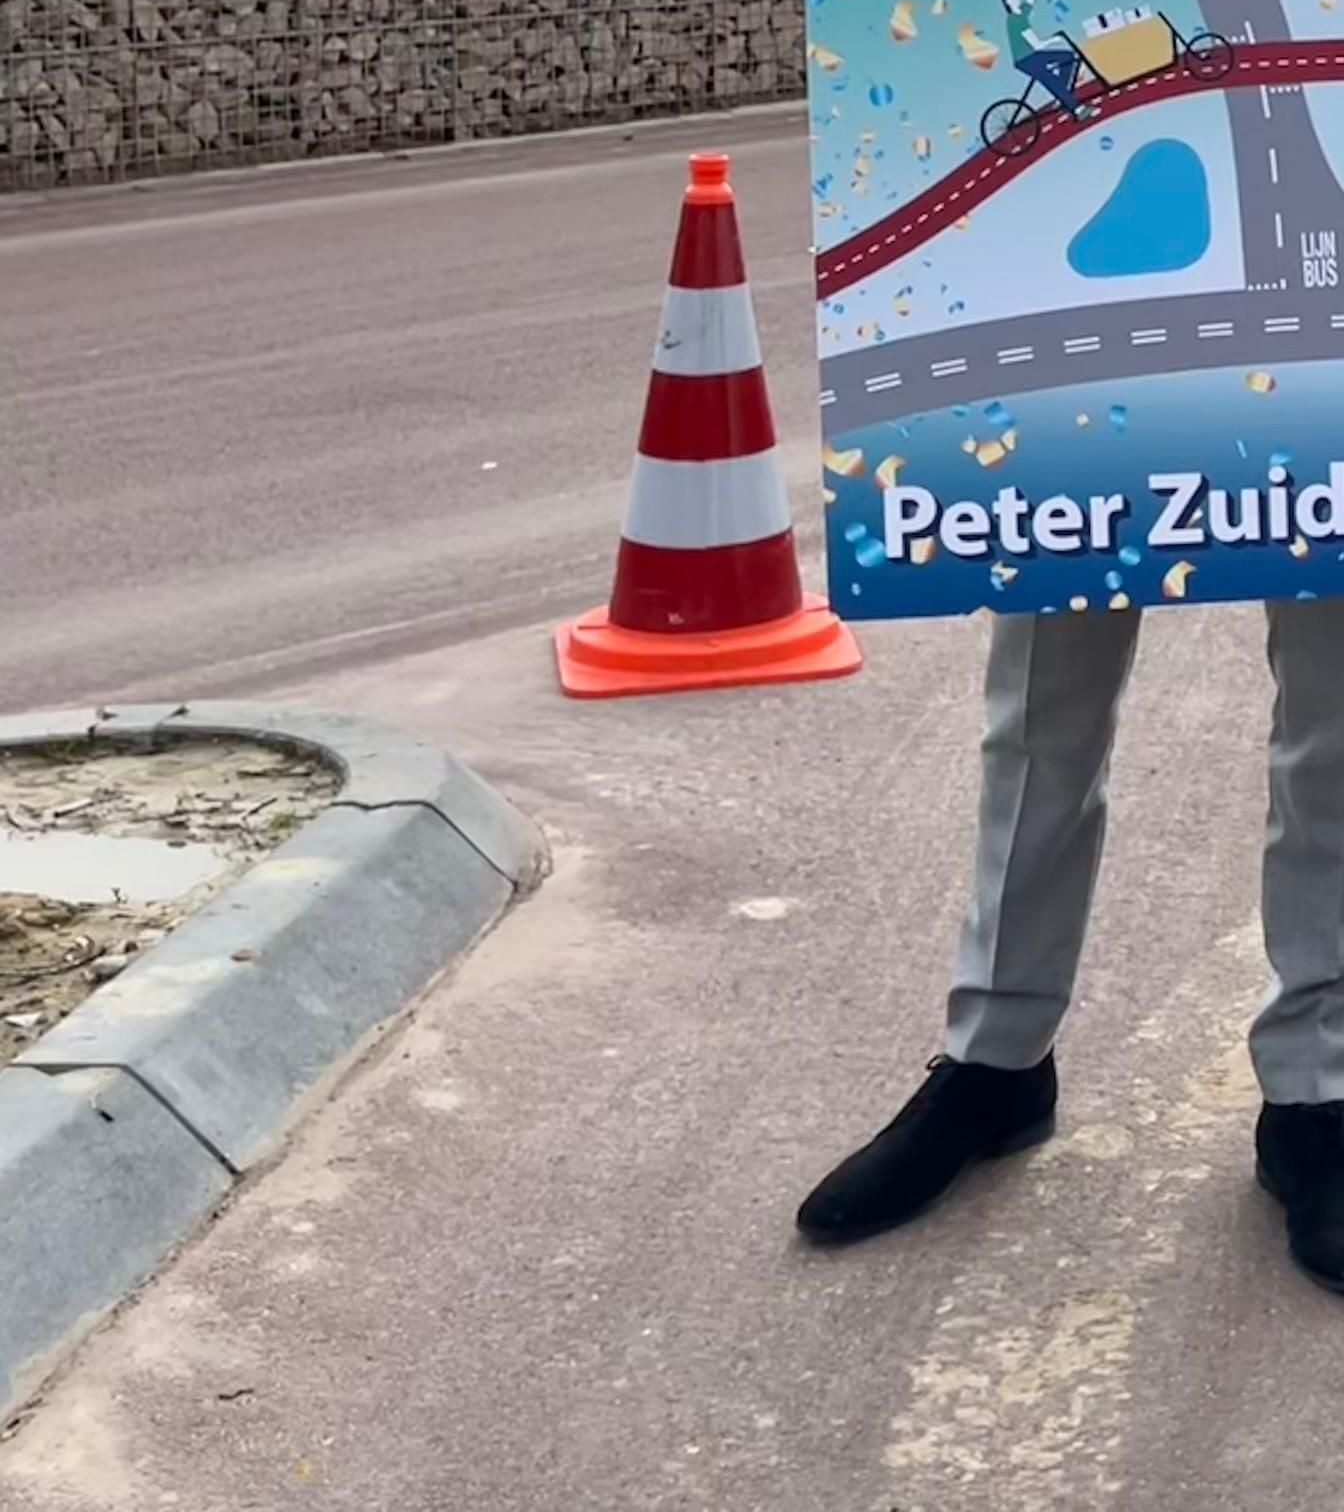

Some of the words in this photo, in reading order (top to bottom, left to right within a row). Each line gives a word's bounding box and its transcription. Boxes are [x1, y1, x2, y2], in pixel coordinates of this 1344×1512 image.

[1301, 231, 1336, 258] LIJN
[1303, 258, 1338, 288] BUS
[882, 484, 1126, 561] Peter
